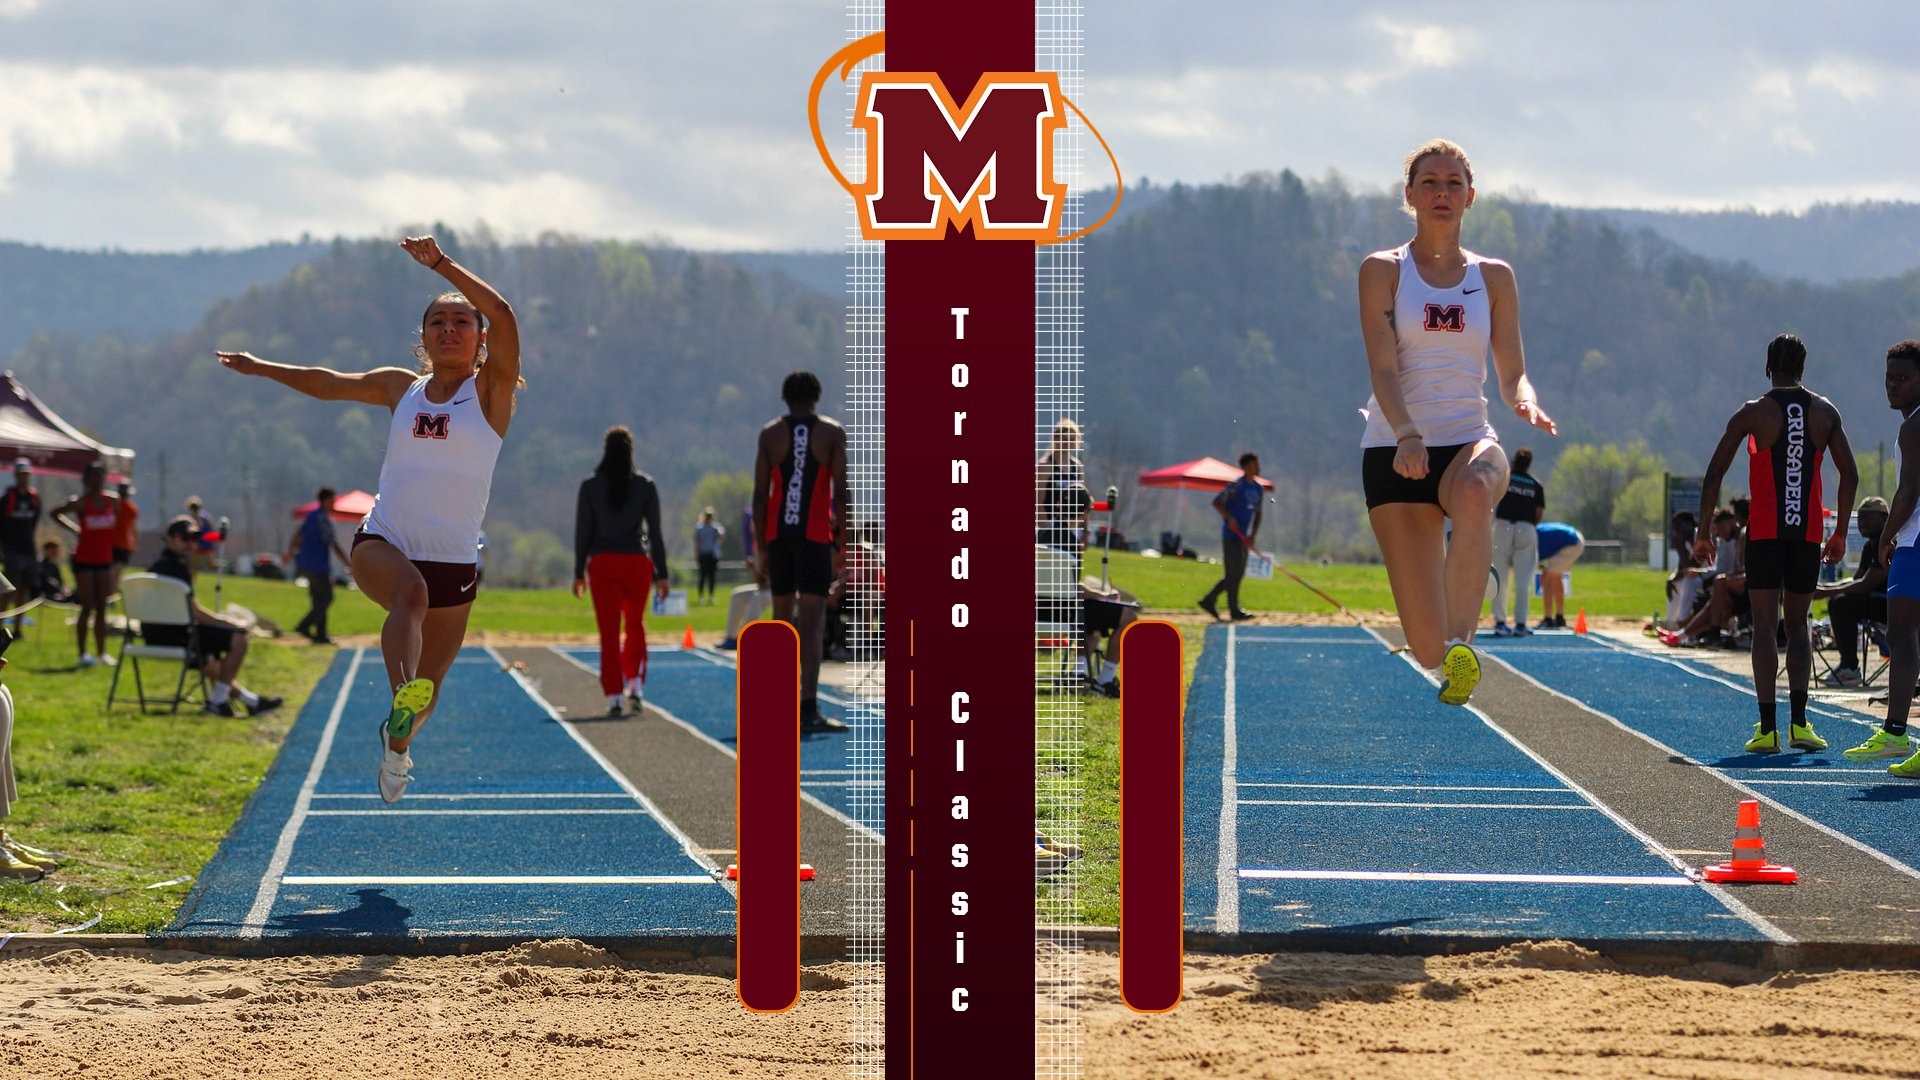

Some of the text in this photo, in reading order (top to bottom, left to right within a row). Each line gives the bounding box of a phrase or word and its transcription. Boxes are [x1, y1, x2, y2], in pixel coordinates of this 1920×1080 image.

[1423, 303, 1466, 333] M
[412, 412, 450, 440] M
[1785, 403, 1804, 527] CRUSADERS
